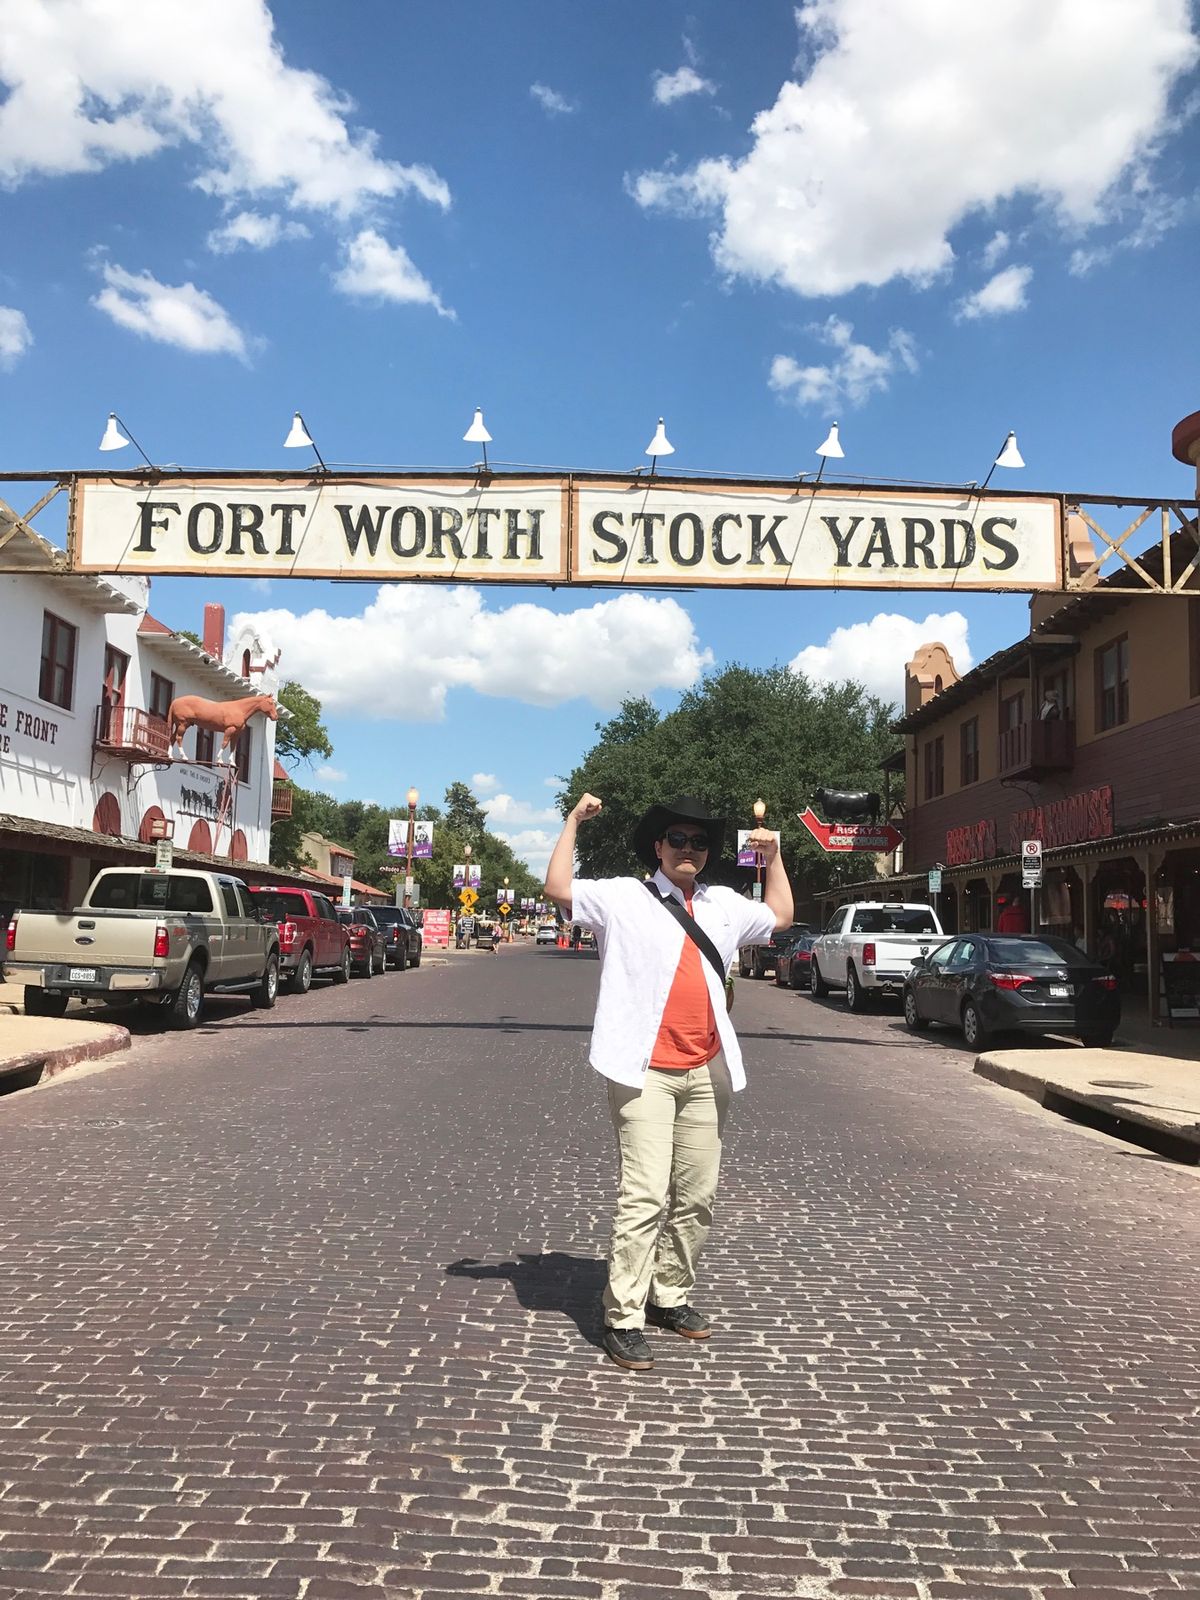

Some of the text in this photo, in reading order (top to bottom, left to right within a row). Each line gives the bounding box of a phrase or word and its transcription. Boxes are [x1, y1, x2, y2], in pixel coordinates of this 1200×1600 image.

[132, 501, 1020, 571] FORT WORTH STOCK YARDS
[15, 709, 58, 745] FRONT
